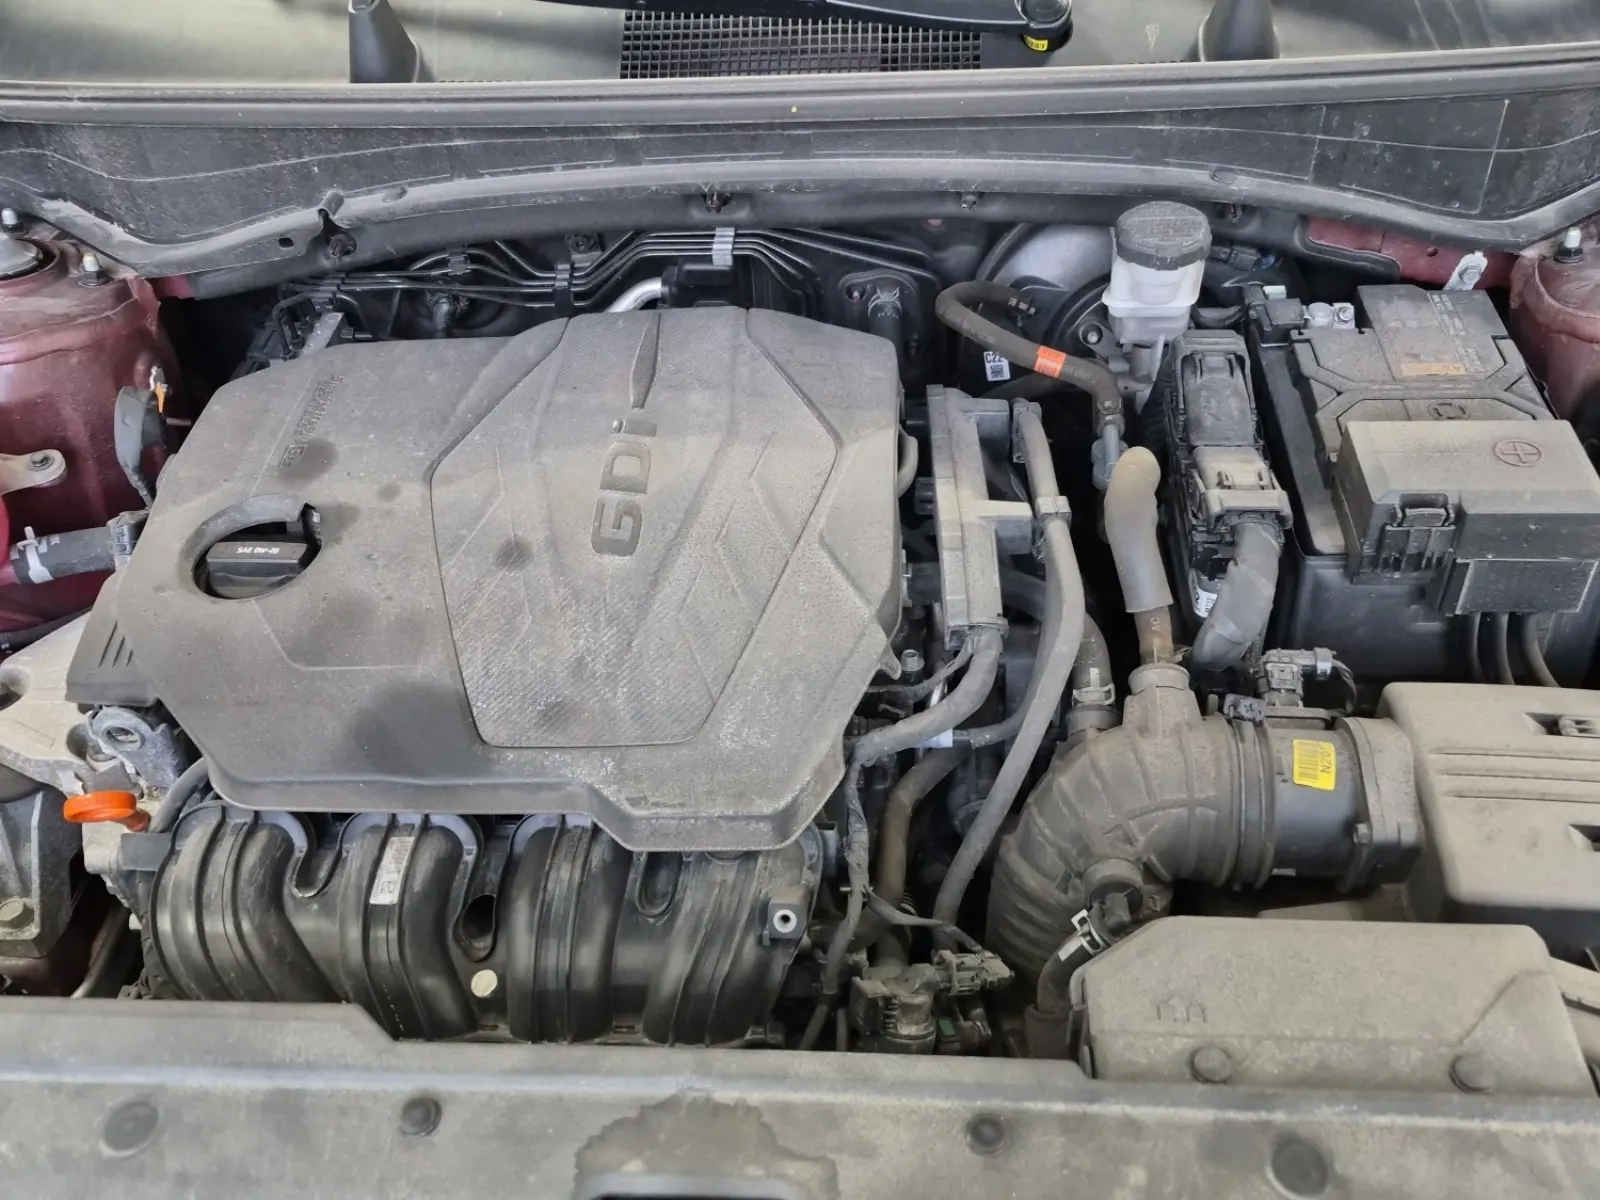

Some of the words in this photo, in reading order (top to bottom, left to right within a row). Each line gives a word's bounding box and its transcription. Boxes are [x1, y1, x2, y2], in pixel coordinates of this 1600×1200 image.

[236, 546, 254, 554] SAE
[253, 546, 280, 555] 0W-20
[1319, 744, 1333, 774] N20
